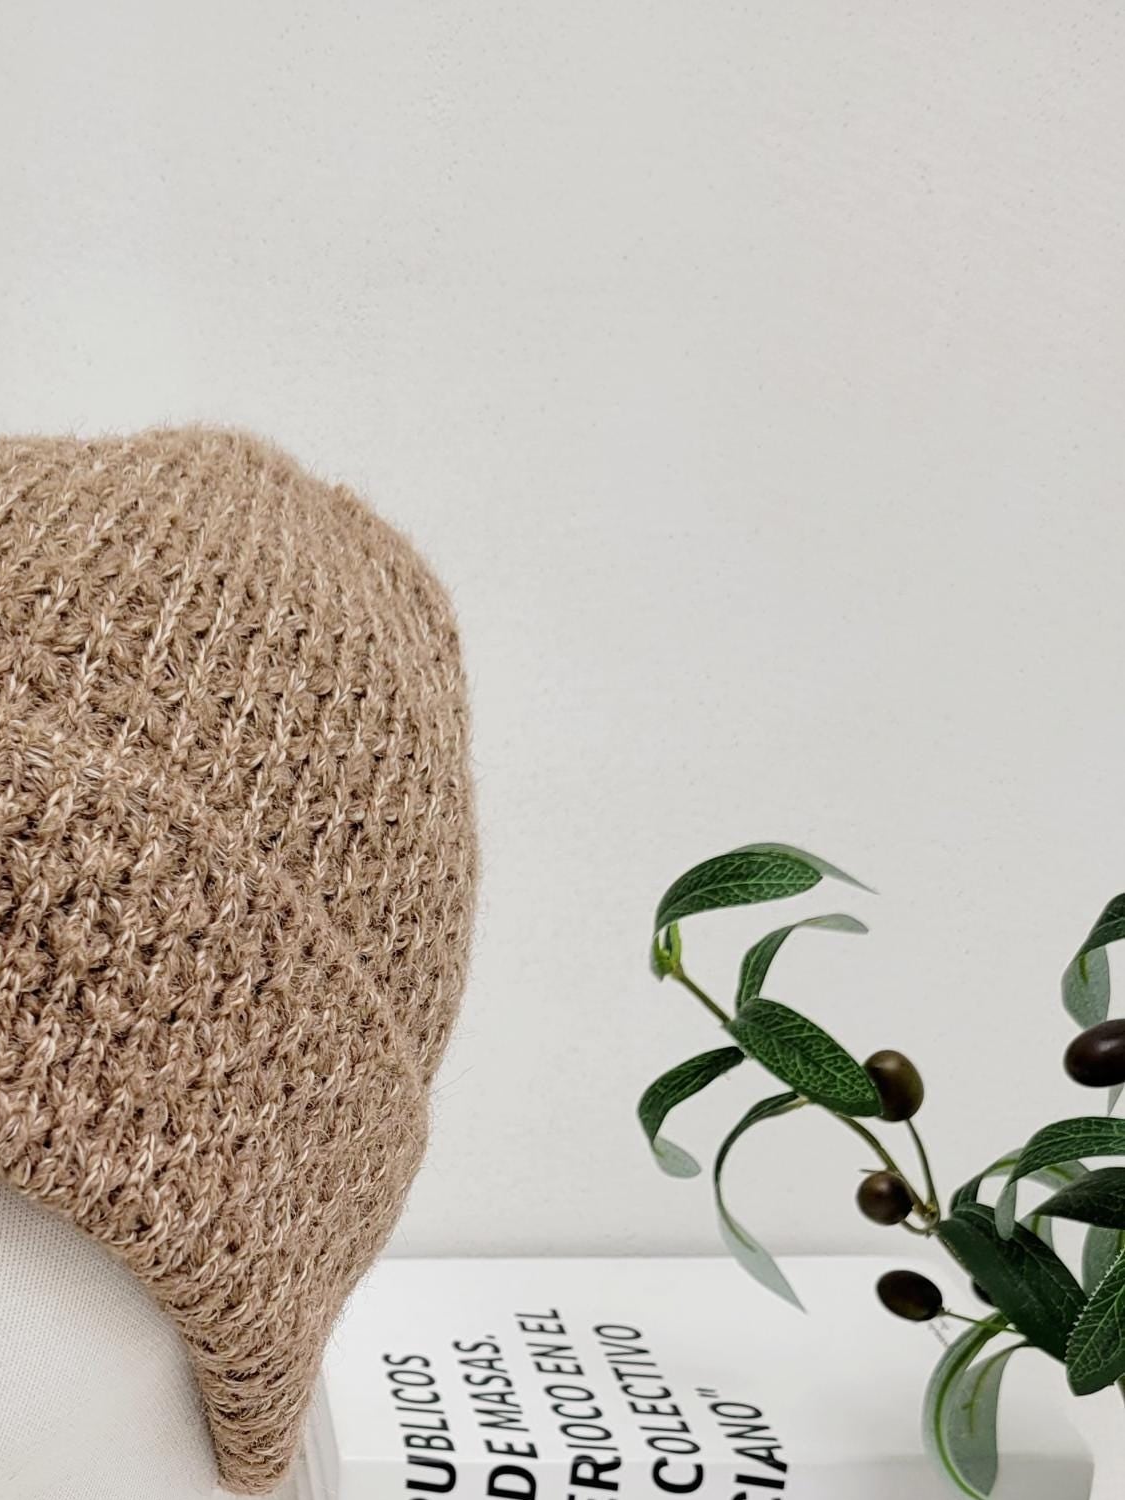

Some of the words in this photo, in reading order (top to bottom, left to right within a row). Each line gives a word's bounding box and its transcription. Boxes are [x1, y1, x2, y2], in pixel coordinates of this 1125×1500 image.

[514, 1307, 569, 1337] EL
[453, 1334, 530, 1433] MASAS.
[526, 1342, 585, 1376] EN
[593, 1324, 704, 1494] COLECTIVO
